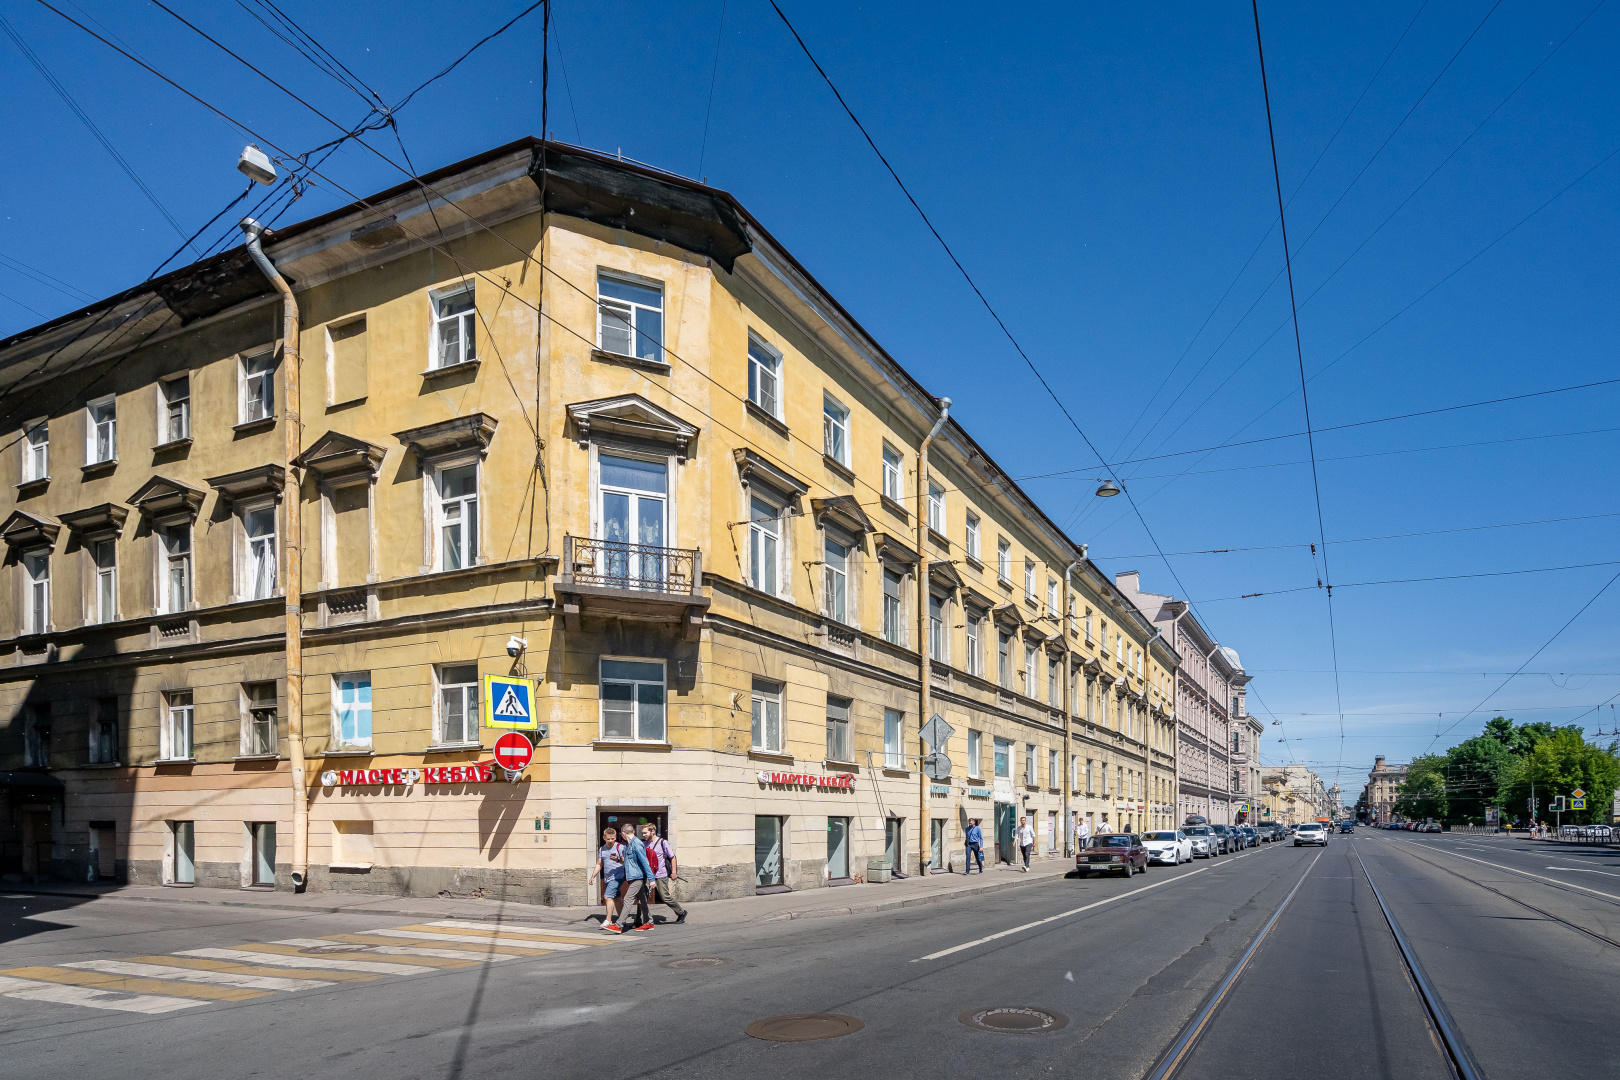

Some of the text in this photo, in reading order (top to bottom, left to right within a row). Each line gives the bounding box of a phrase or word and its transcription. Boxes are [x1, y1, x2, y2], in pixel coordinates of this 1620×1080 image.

[340, 766, 494, 786] МАСТЕР КЕБАБ
[771, 772, 850, 788] МАСТЕР КЕБАБ
